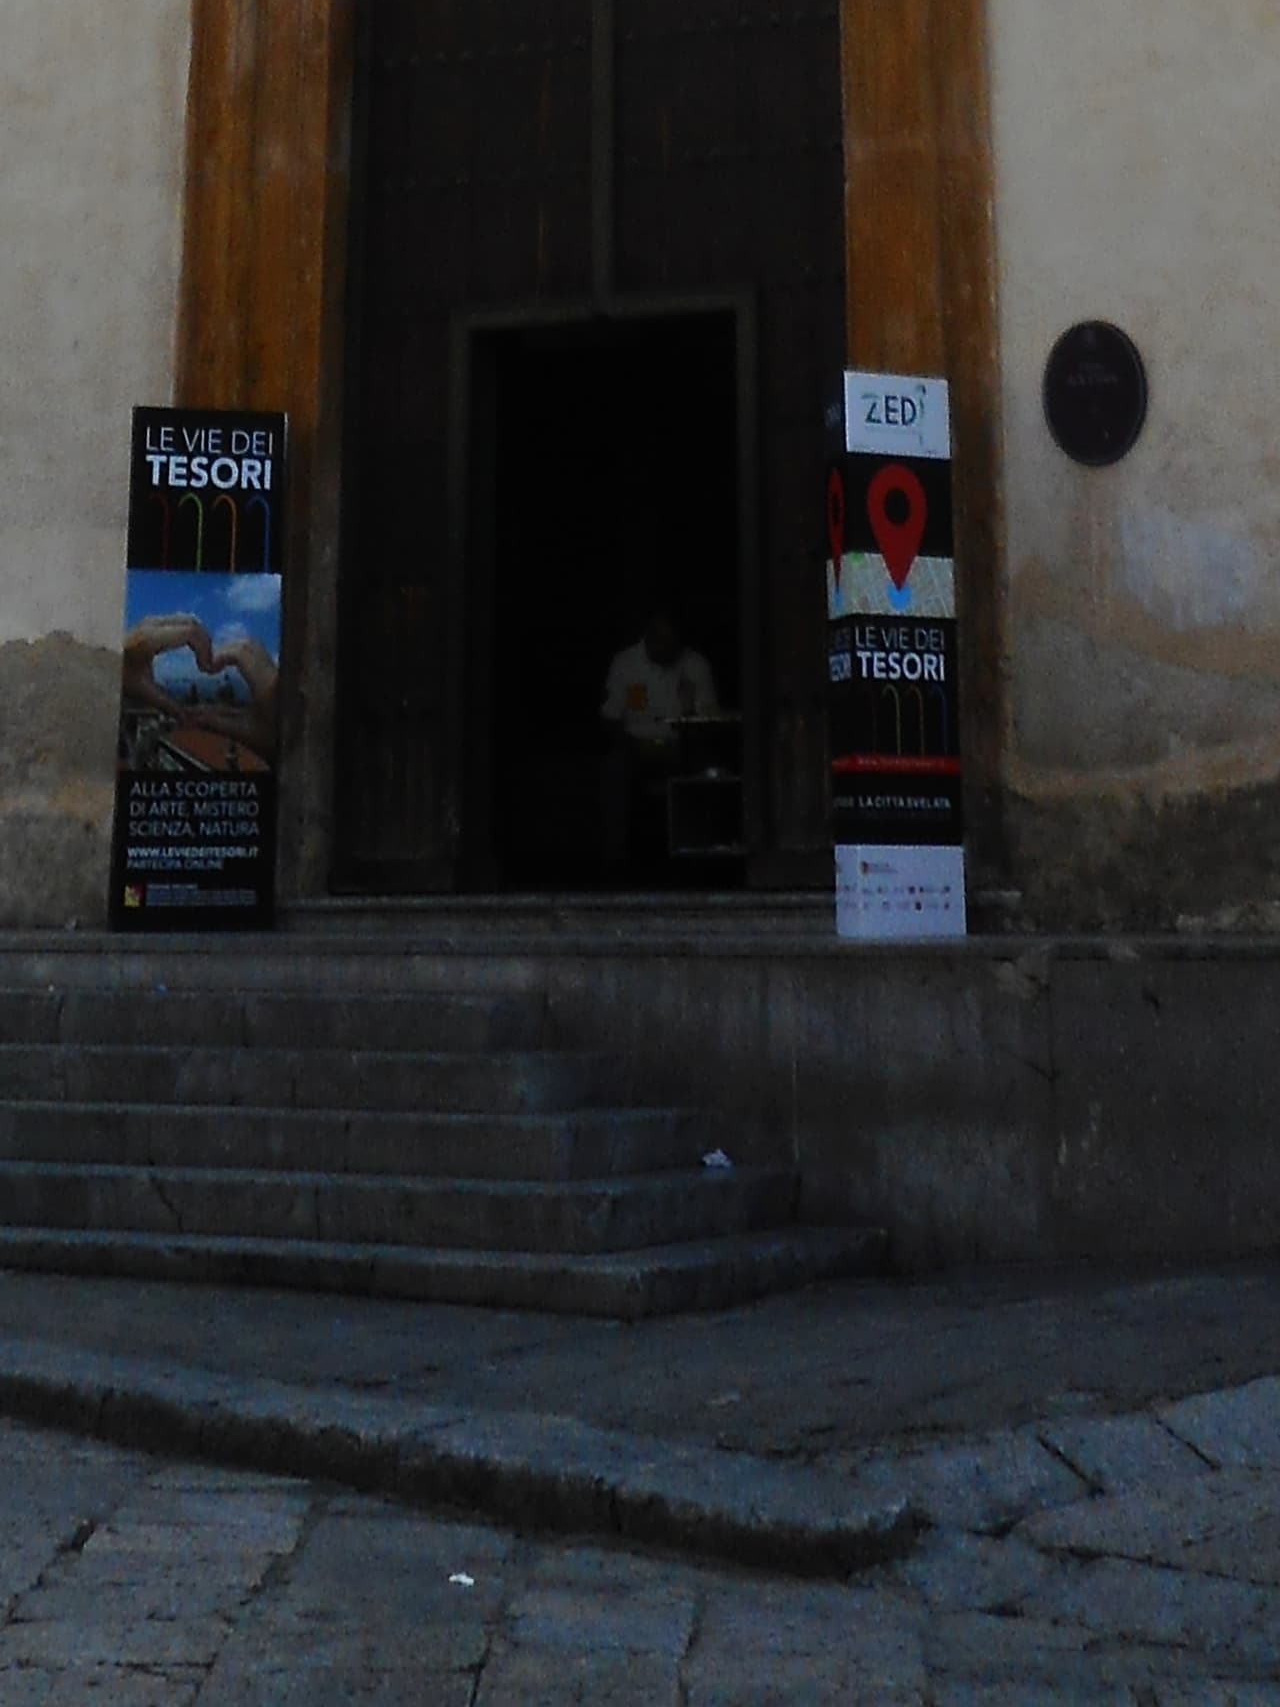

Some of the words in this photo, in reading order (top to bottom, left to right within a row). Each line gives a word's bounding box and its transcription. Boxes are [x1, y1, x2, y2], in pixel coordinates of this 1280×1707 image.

[146, 426, 174, 451] LE
[183, 427, 222, 454] VIE
[232, 429, 273, 456] DEI
[146, 455, 272, 490] TESORI
[855, 626, 876, 648] LE
[881, 627, 909, 649] VIE
[915, 628, 944, 651] DEI
[856, 651, 945, 681] TESORI
[130, 781, 170, 797] ALLA
[175, 781, 258, 797] SCOPERTA
[130, 801, 145, 816] DI
[193, 801, 259, 817] MISTERO
[200, 821, 259, 836] NATURA
